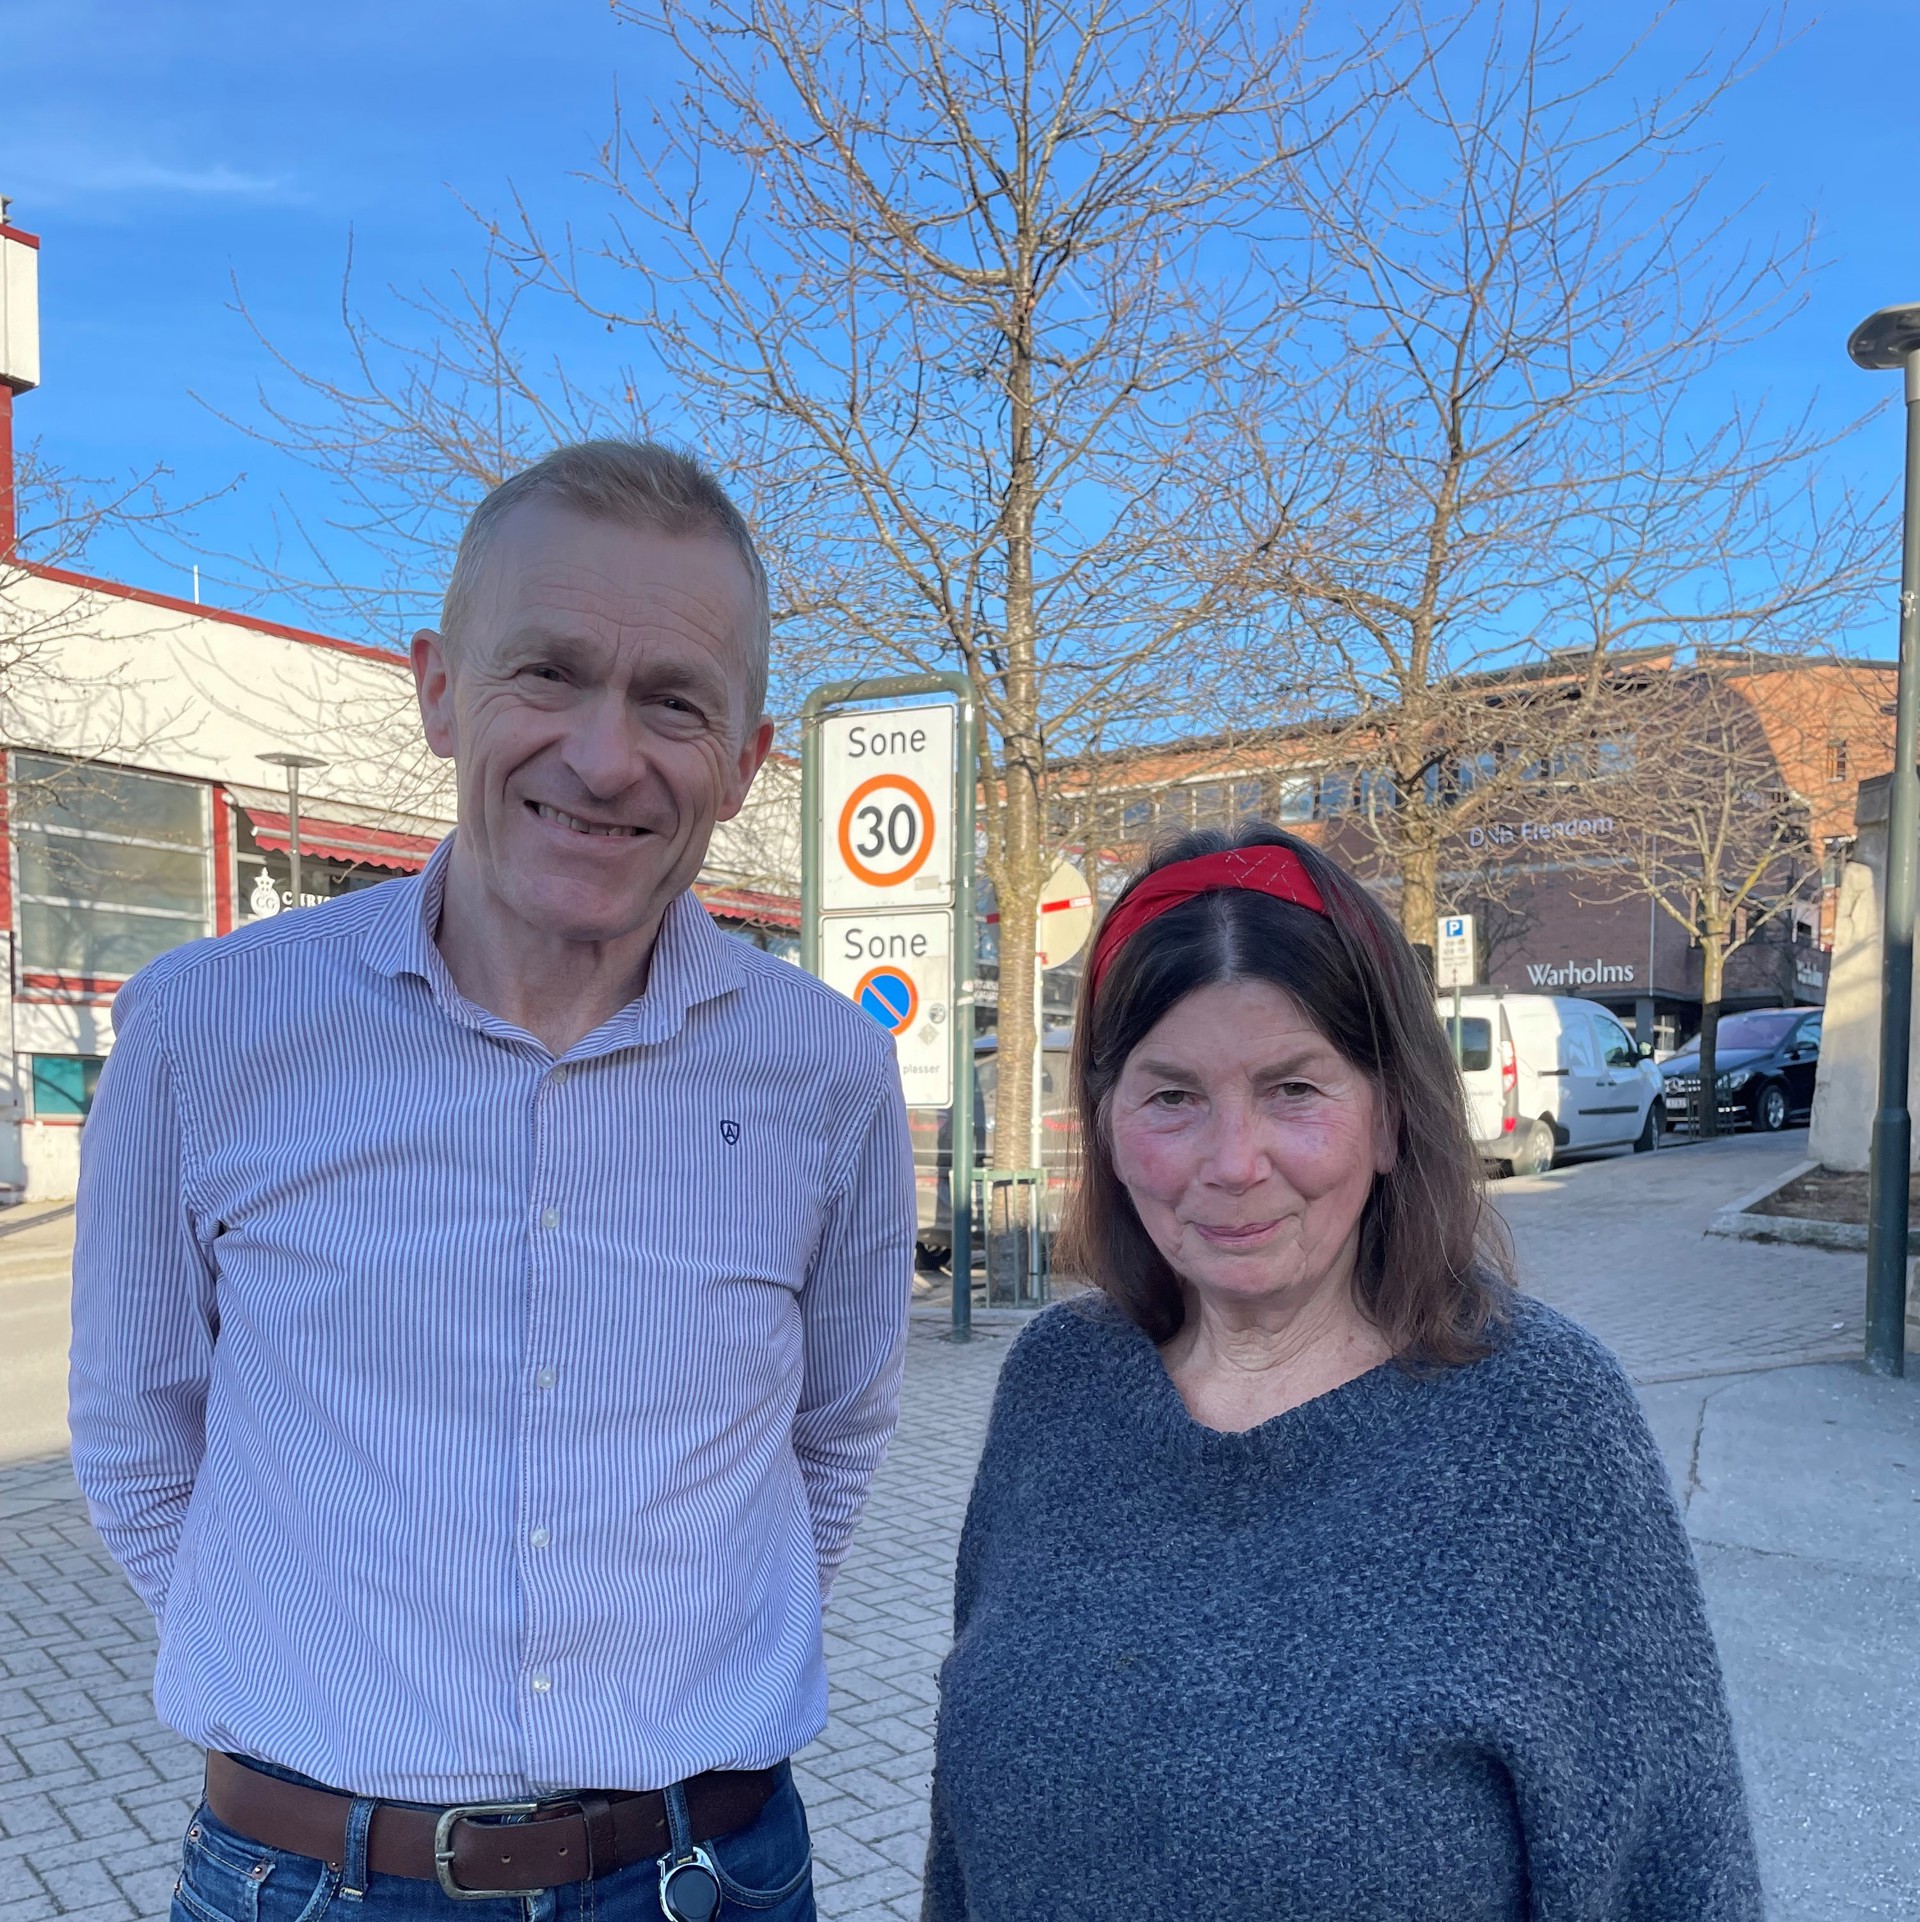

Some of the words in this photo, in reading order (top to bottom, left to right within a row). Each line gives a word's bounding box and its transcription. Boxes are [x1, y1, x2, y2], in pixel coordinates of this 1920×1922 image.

[848, 726, 926, 758] Sone
[857, 803, 916, 858] 30
[844, 928, 927, 959] Sone
[1526, 958, 1635, 987] Warholms
[903, 1064, 940, 1075] plasser
